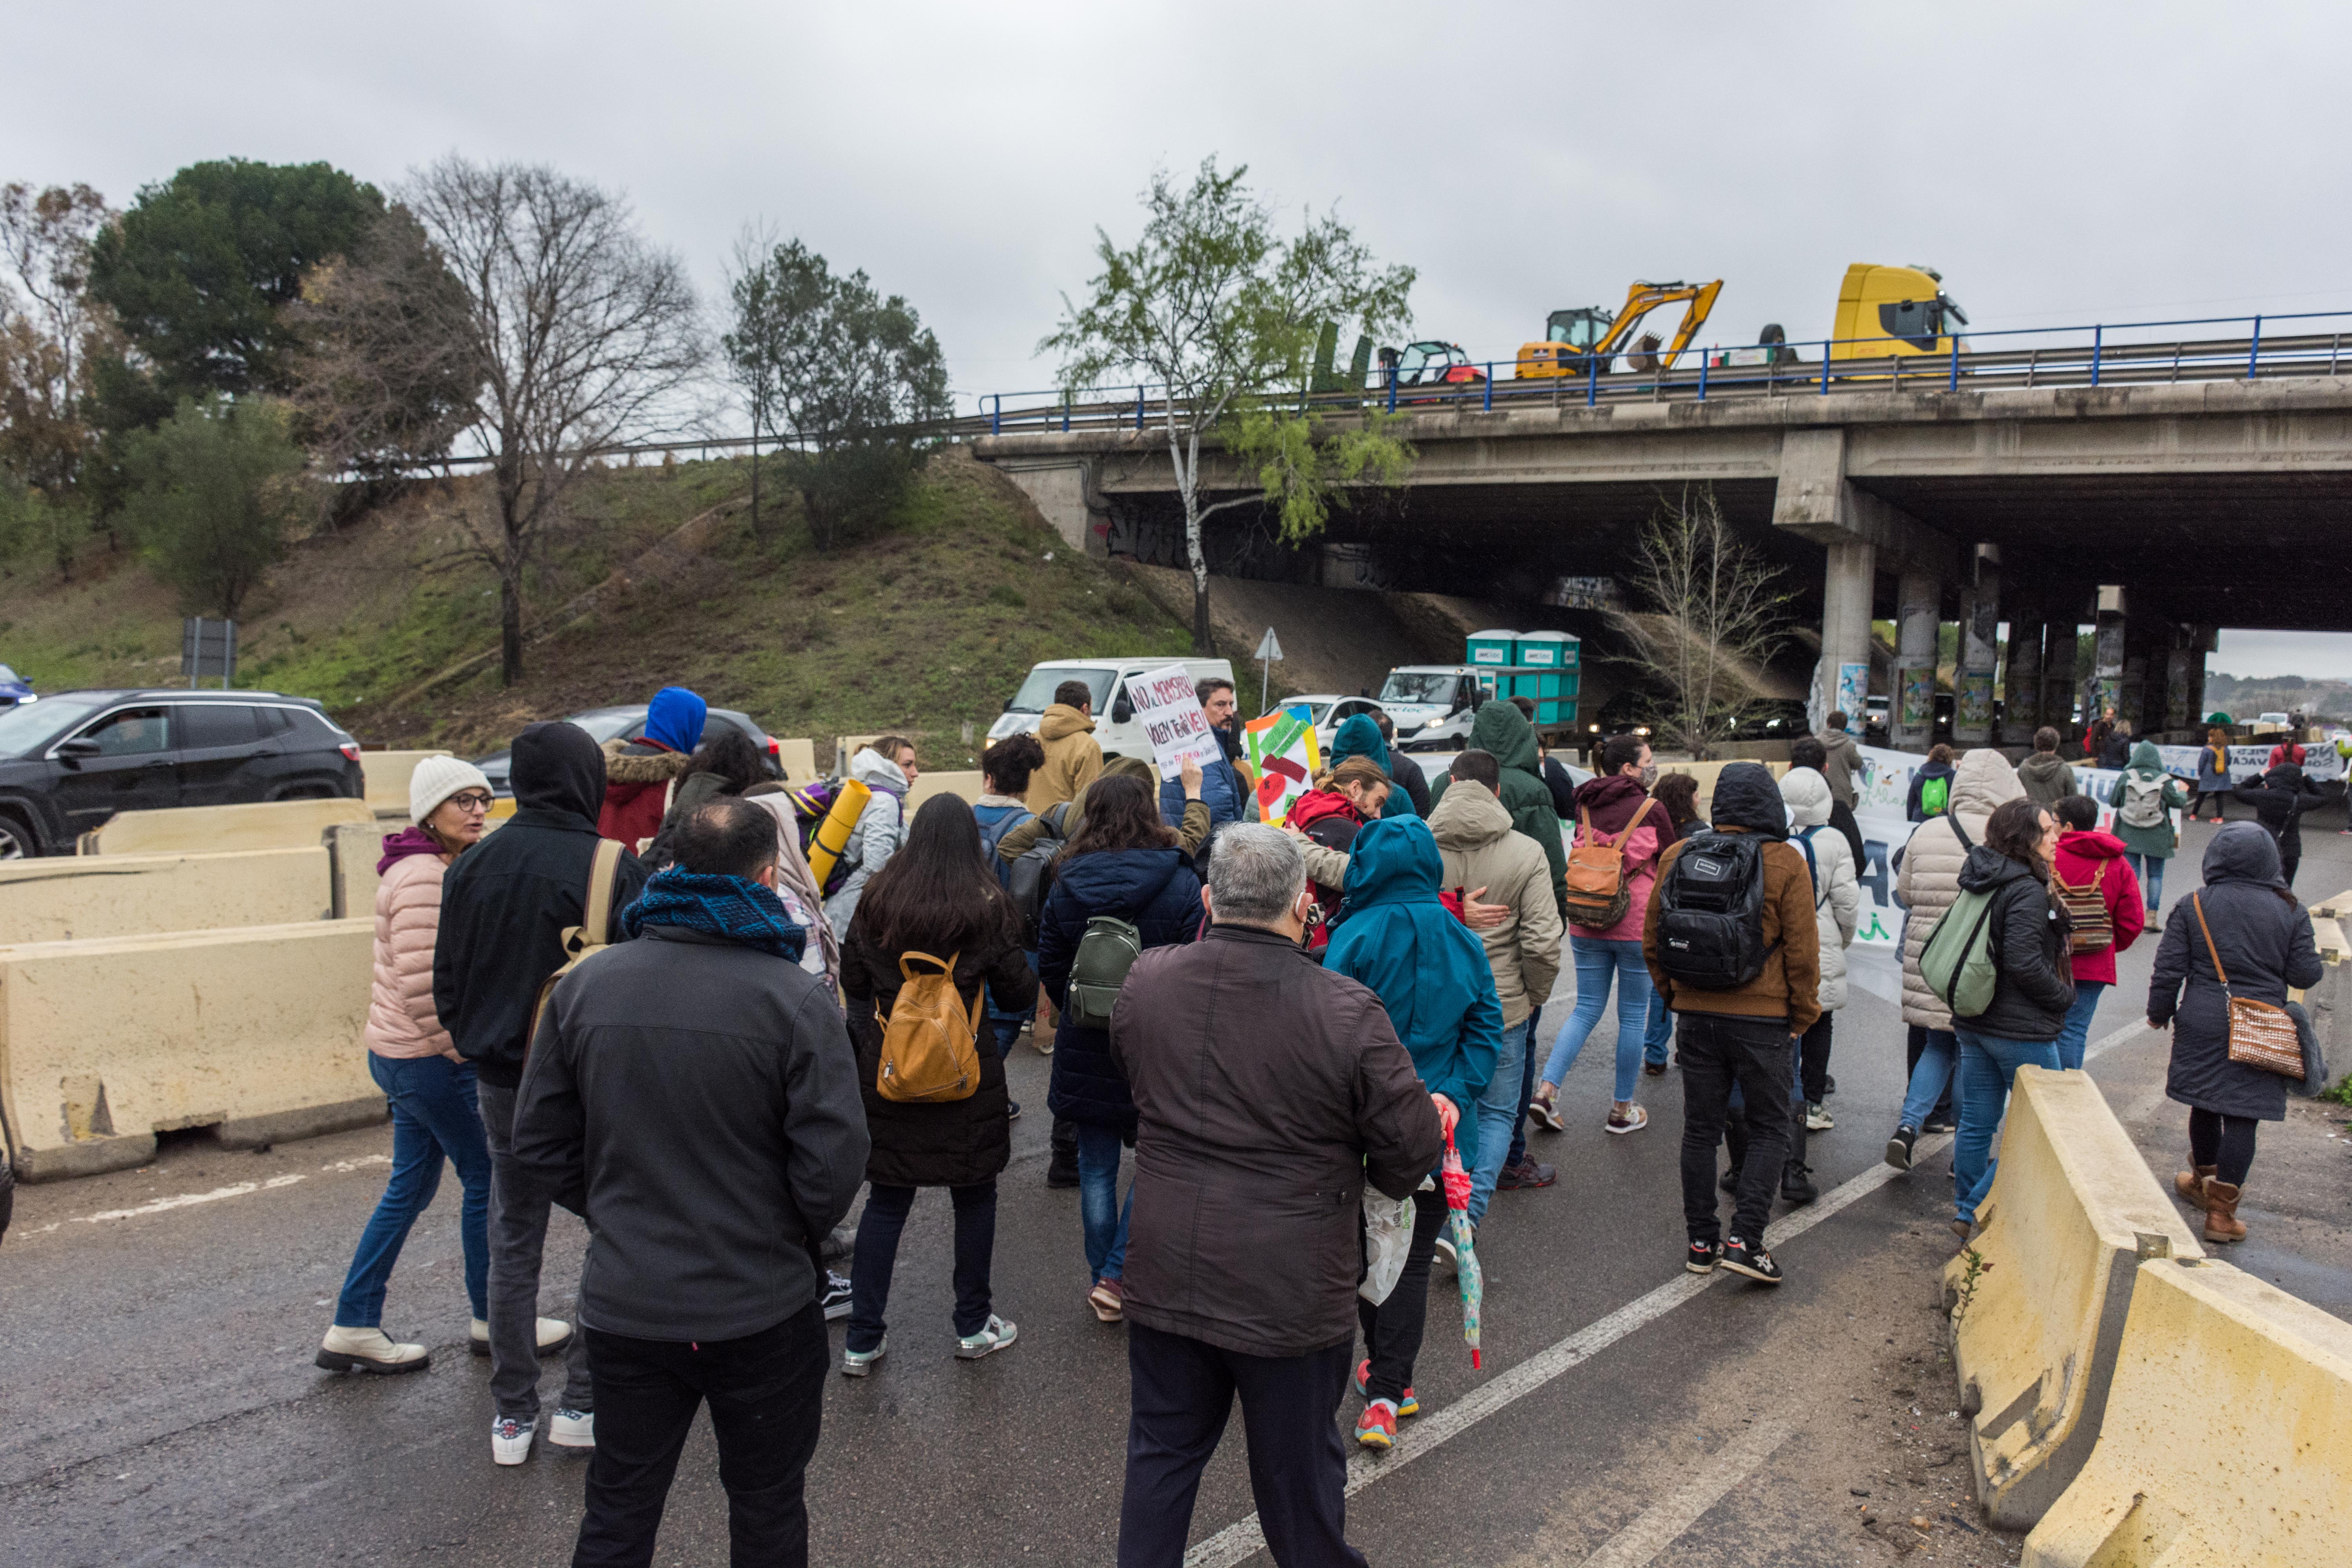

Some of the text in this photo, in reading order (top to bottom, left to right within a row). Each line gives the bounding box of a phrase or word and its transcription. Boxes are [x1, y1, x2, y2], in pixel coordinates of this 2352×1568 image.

[1130, 684, 1151, 713] NO
[1145, 720, 1174, 747] VOLEM
[1184, 709, 1207, 733] VEU
